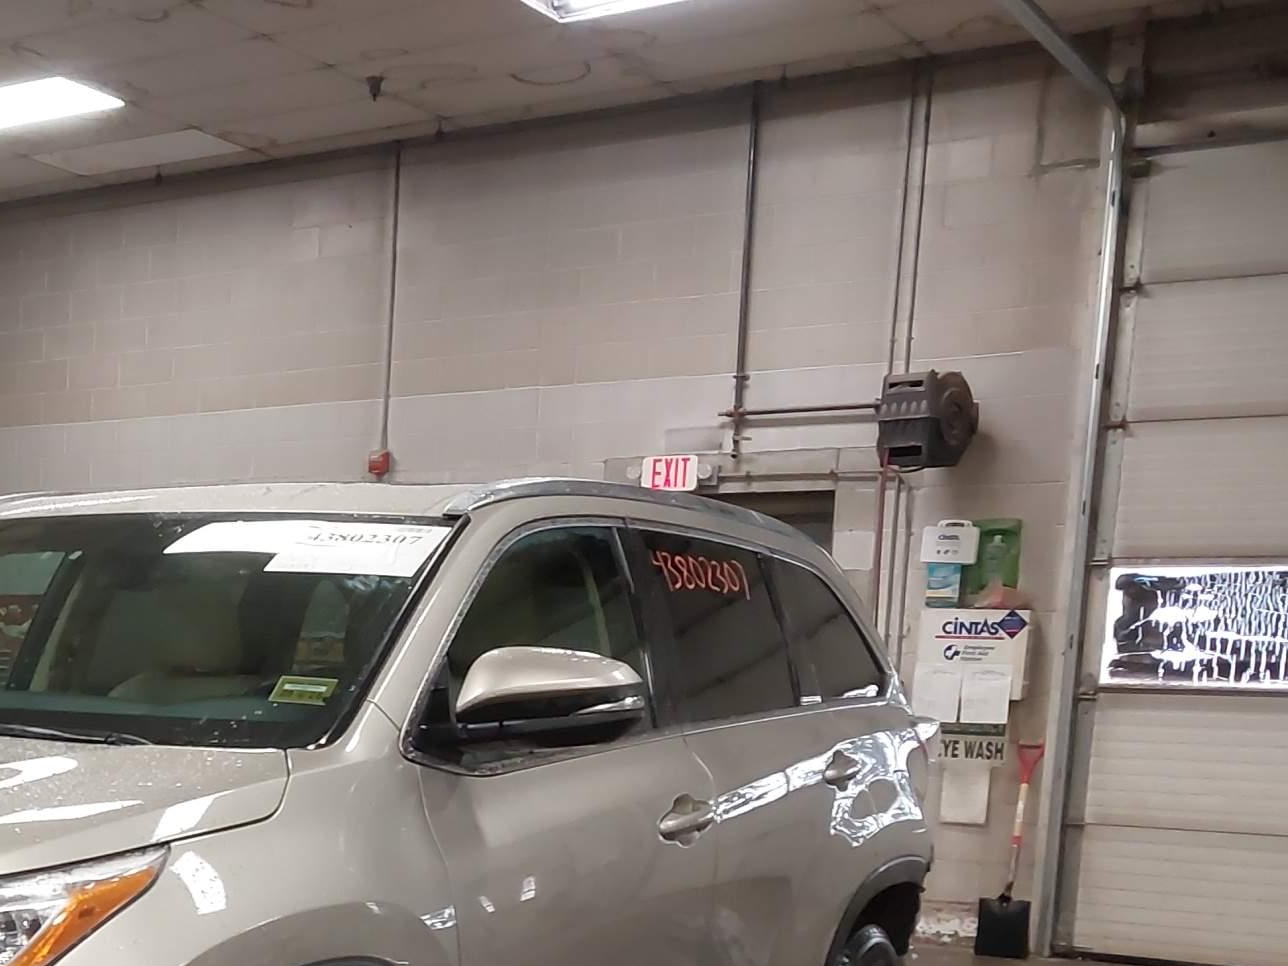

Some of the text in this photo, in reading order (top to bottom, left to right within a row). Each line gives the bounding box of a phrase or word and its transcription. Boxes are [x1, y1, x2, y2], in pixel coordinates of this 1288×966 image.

[652, 457, 691, 489] EXIT
[649, 551, 751, 601] 43802307
[941, 616, 1001, 637] CINTAS
[938, 740, 1005, 761] YE WASH
